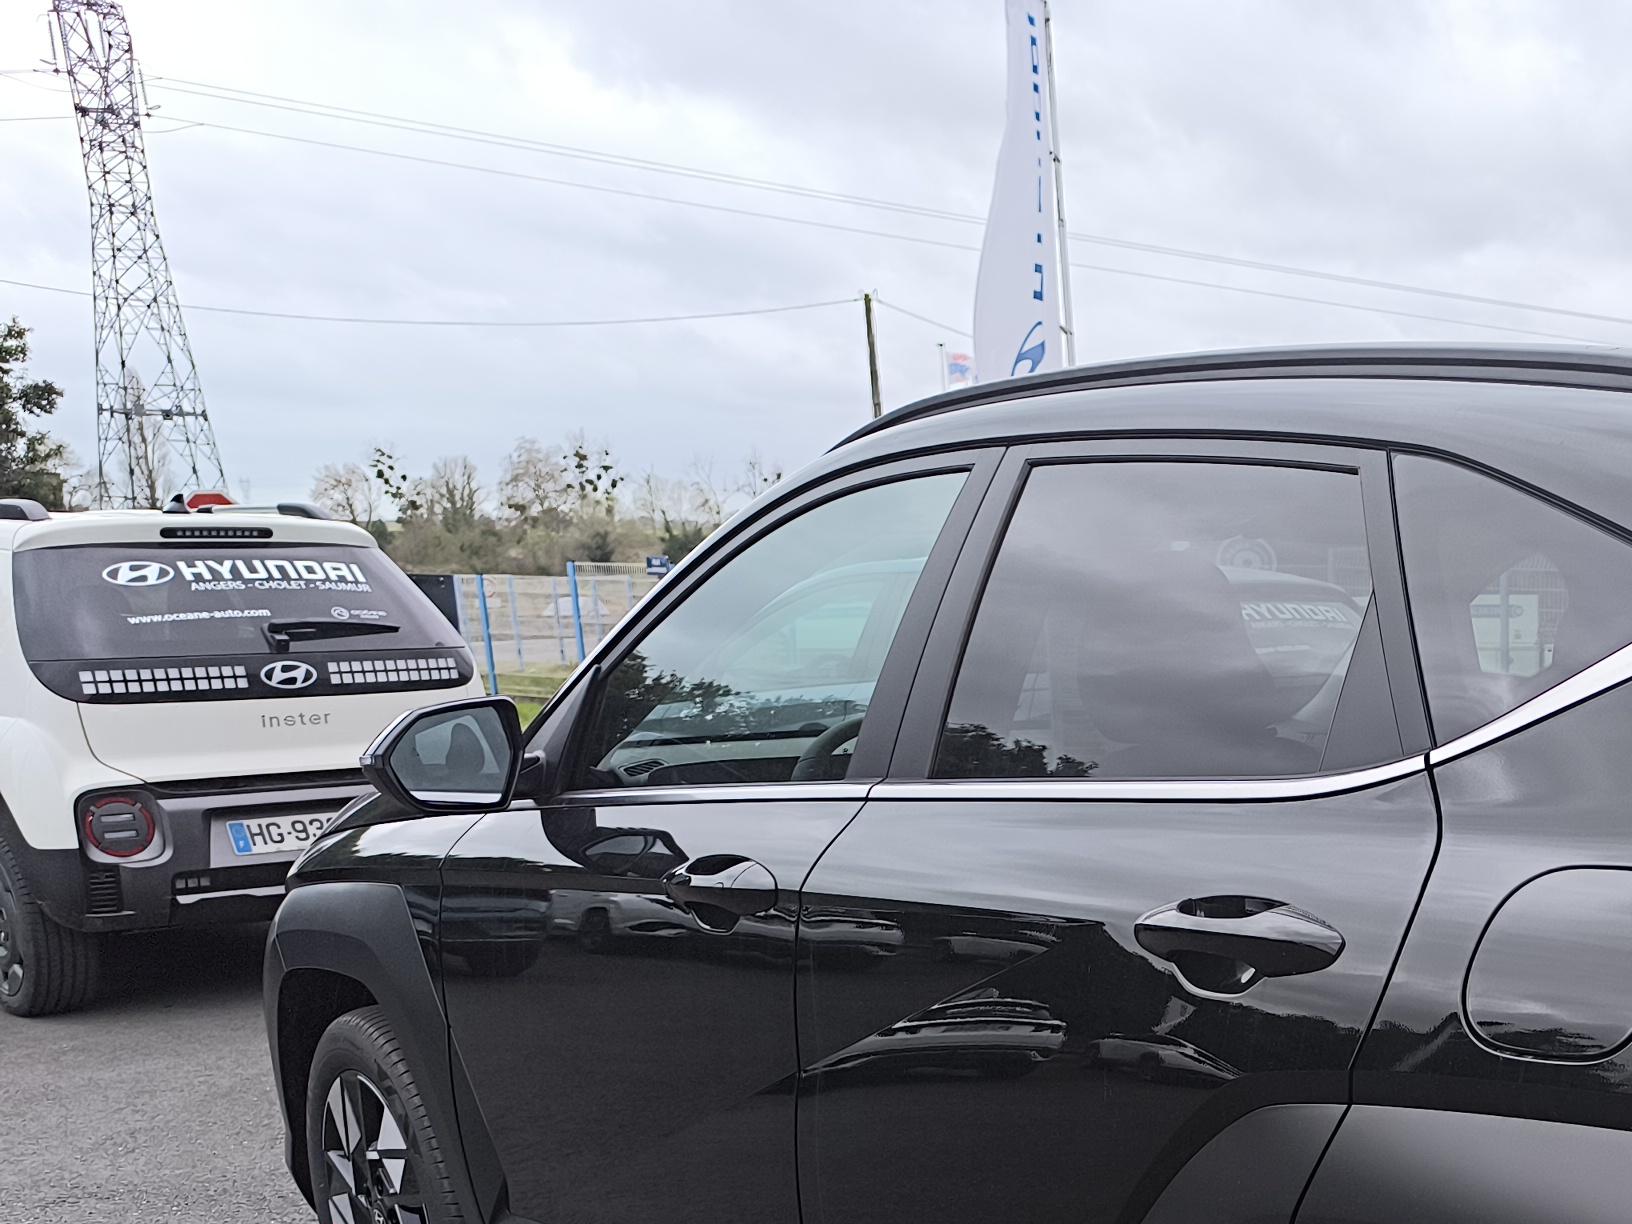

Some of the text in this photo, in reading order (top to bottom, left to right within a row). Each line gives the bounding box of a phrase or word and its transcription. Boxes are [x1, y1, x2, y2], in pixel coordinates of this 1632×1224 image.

[176, 560, 367, 583] HYUNDAI
[191, 581, 246, 591] ANGERS
[254, 580, 306, 590] CHOLET
[315, 581, 373, 593] SAUMUR
[127, 607, 271, 625] www.oceane-auto.com
[261, 713, 331, 728] inster
[246, 817, 334, 847] HG-93
